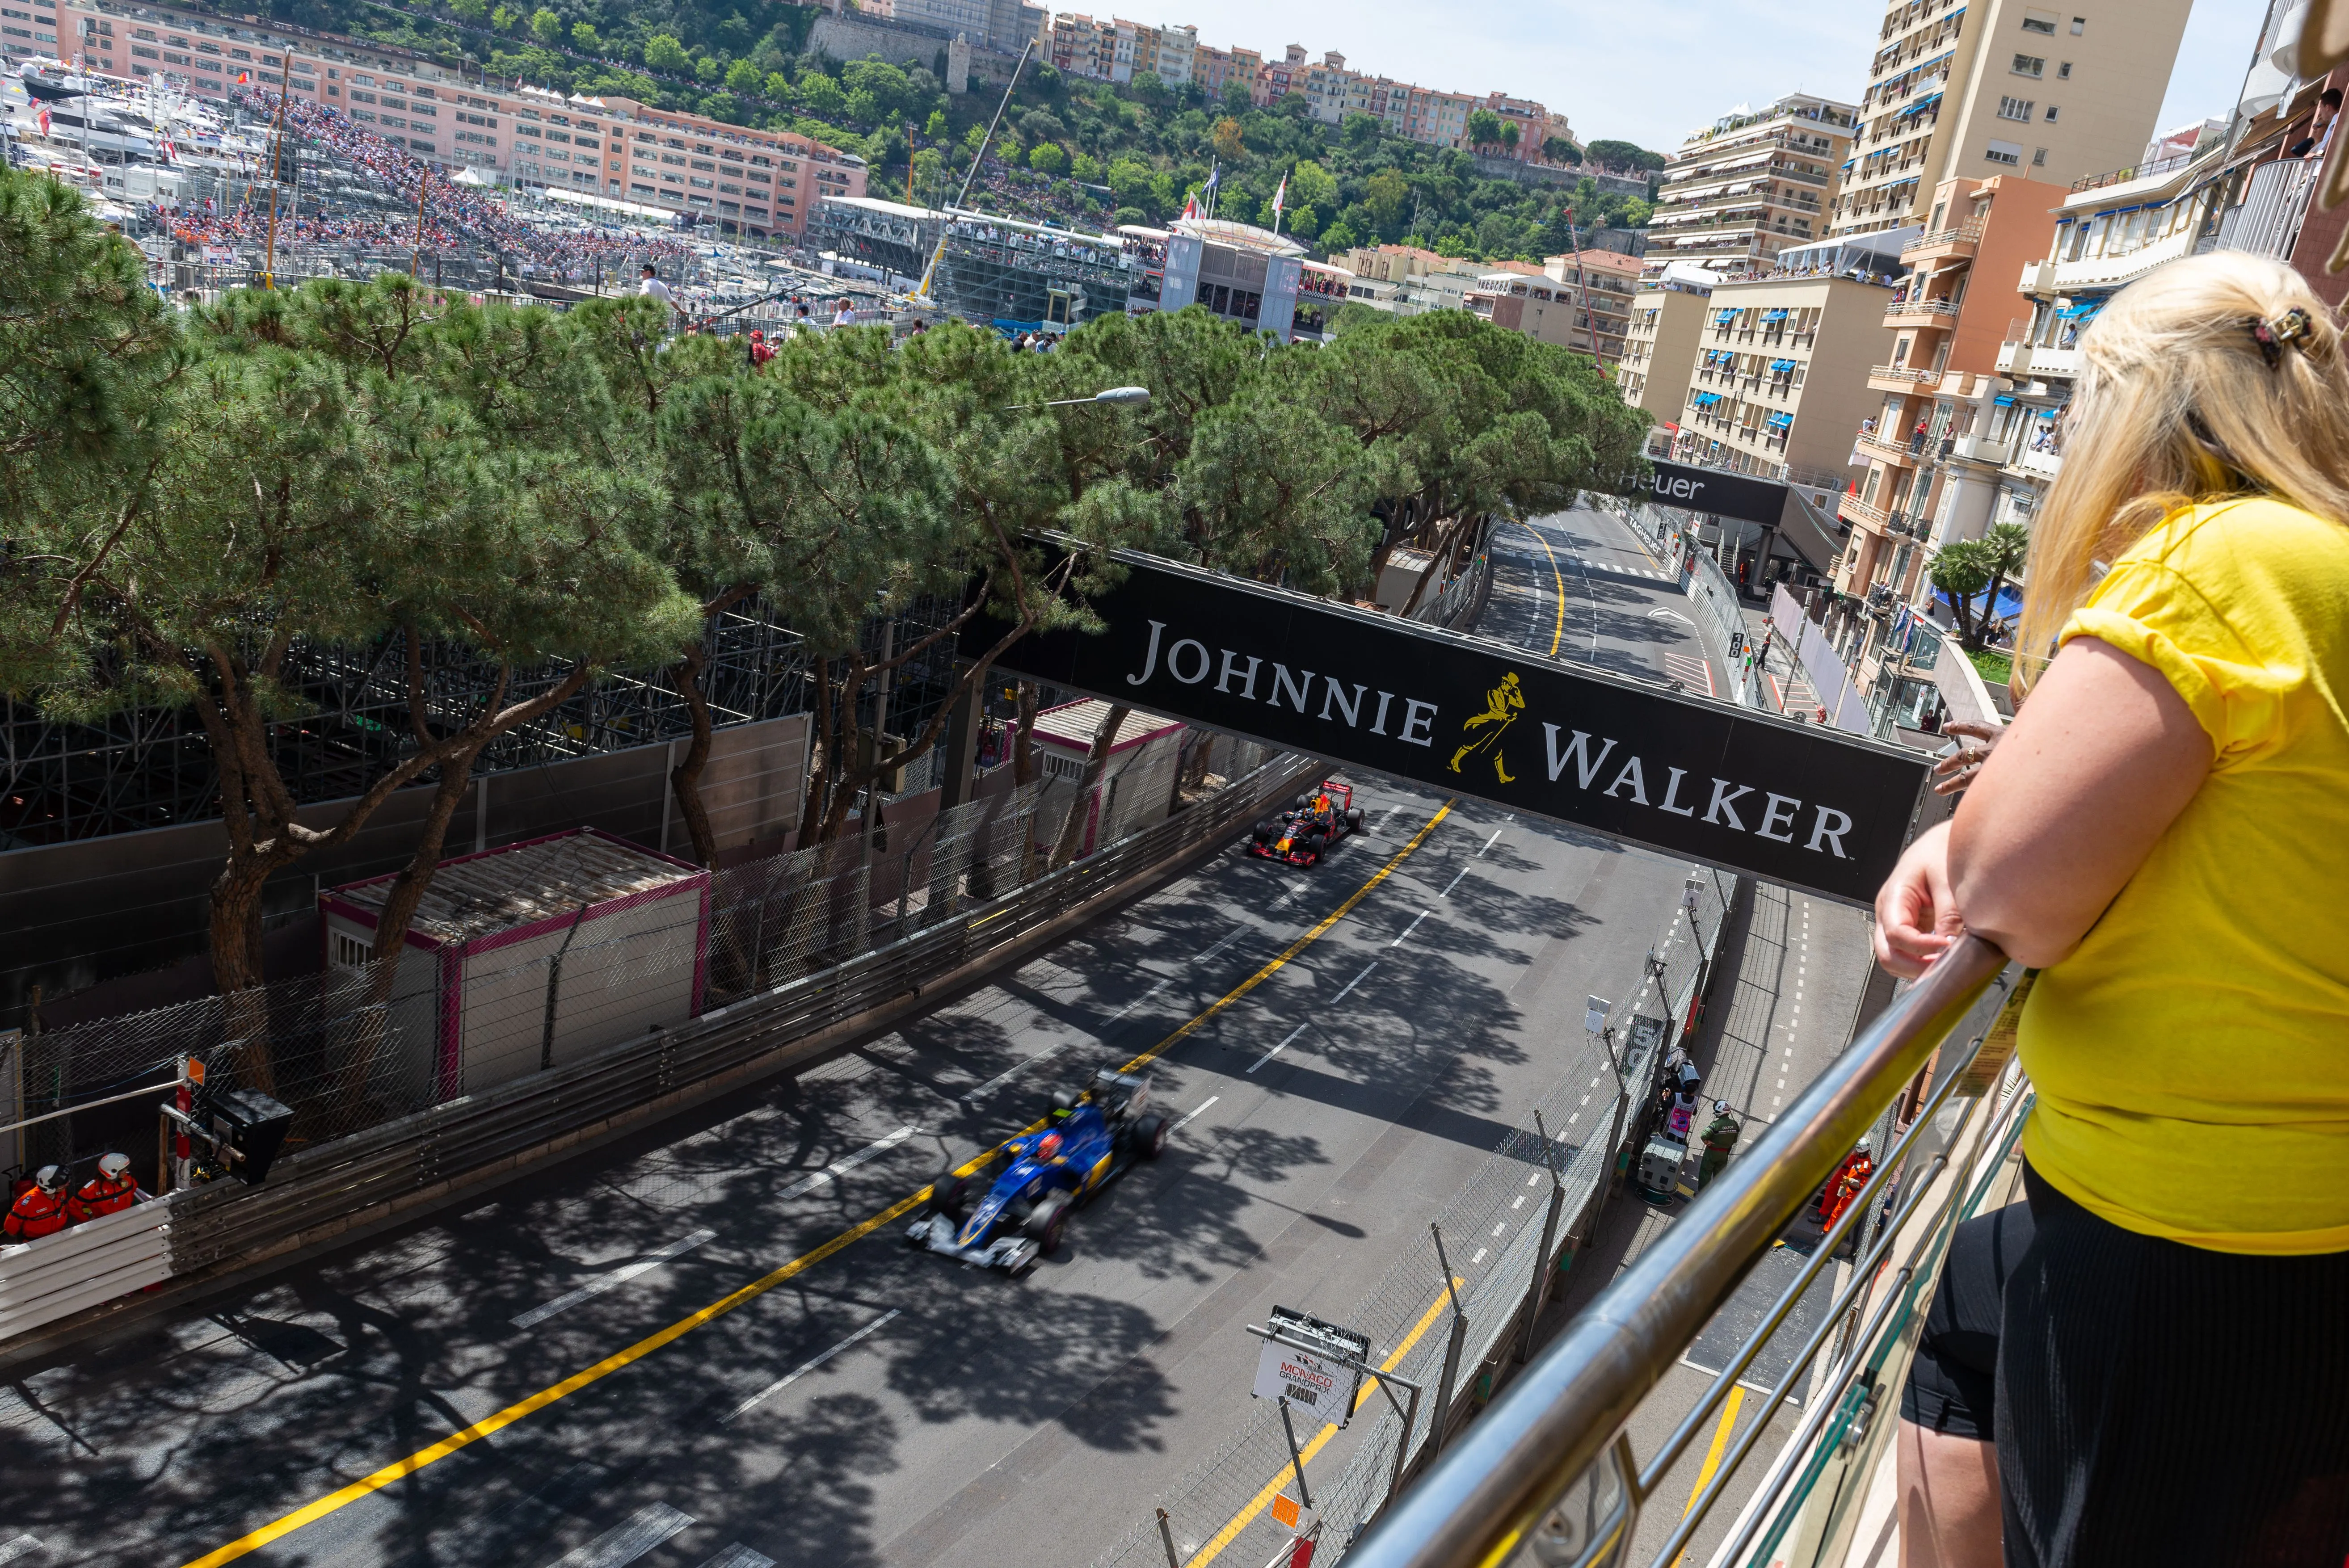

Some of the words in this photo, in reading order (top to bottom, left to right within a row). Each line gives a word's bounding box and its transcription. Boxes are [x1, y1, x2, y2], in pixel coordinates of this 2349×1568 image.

[1730, 634, 1742, 657] 100
[1127, 619, 1439, 747] JOHNNIE
[1542, 722, 1852, 858] WALKER
[1281, 1362, 1332, 1387] MONACO
